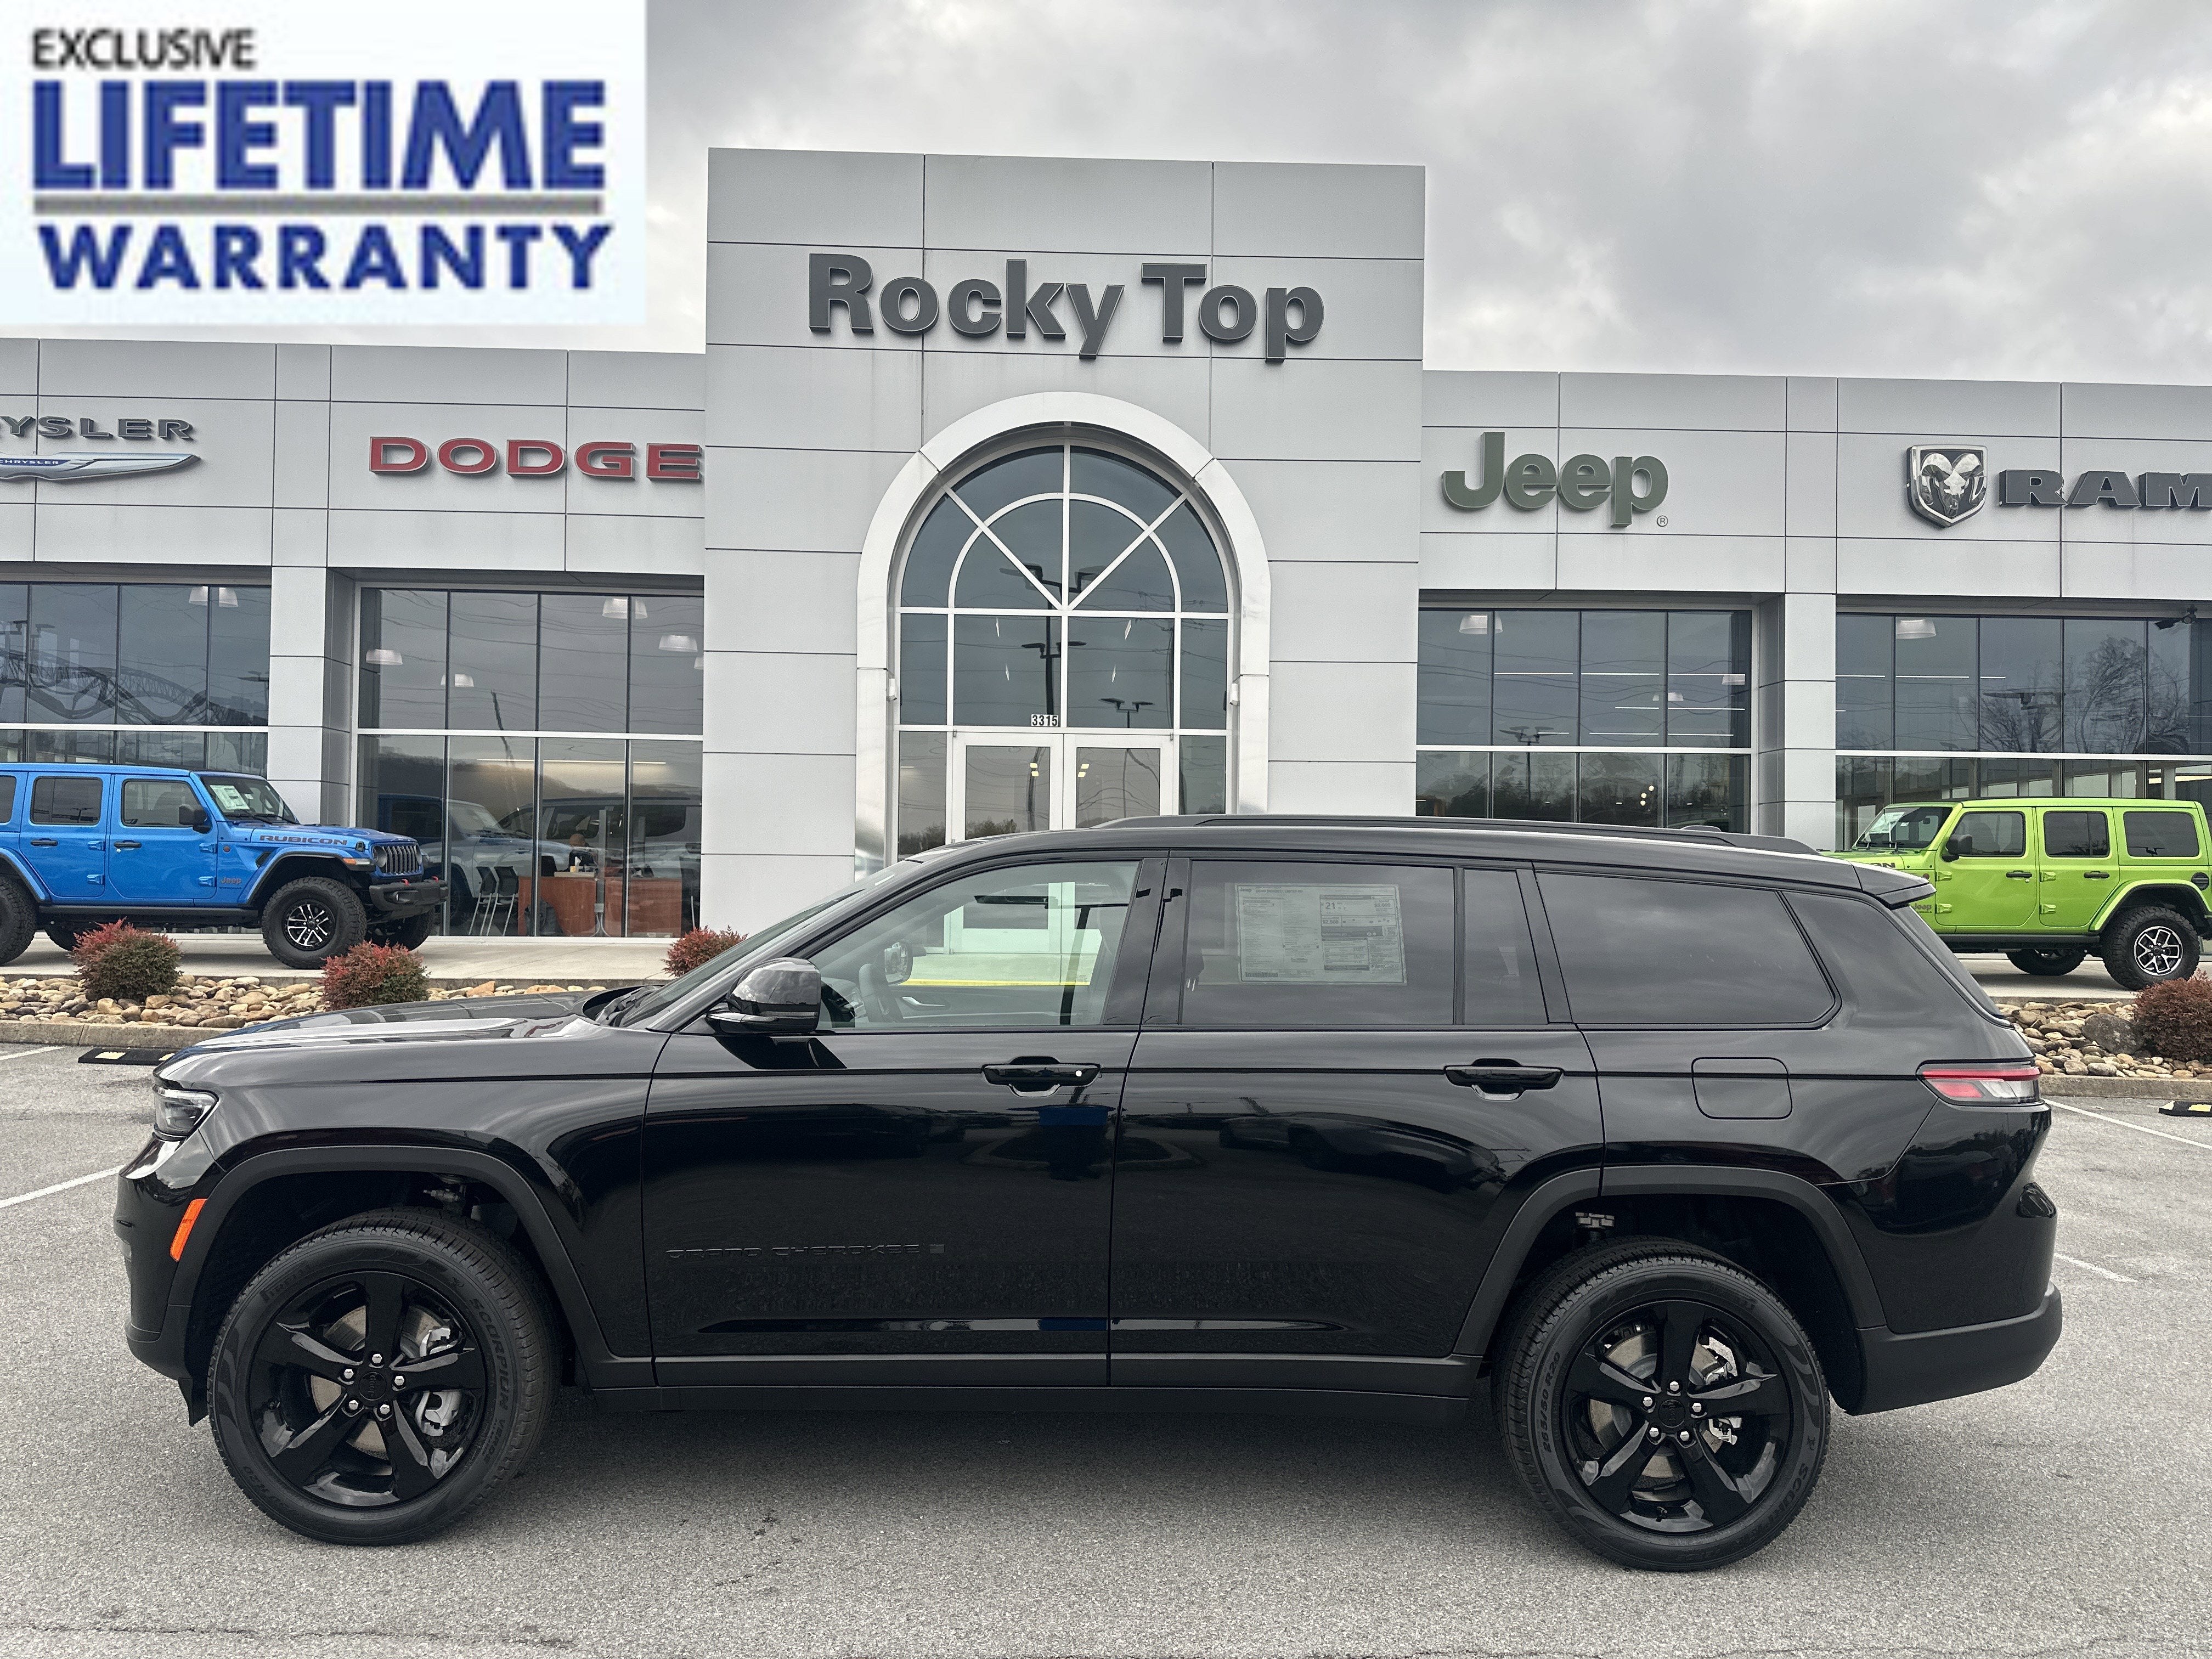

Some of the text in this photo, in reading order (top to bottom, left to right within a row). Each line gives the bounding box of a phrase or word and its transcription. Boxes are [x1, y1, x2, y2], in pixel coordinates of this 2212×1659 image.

[809, 253, 1325, 362] Rocky Top
[369, 437, 703, 482] DODGE
[1441, 432, 1668, 527] Jeep
[1999, 469, 2212, 507] RAM
[1032, 715, 1057, 726] 3315
[259, 834, 348, 845] RUBICON
[771, 1244, 921, 1256] CHEROKEE
[467, 1295, 510, 1410] SCORPION
[1539, 1350, 1562, 1454] 265/50 R20
